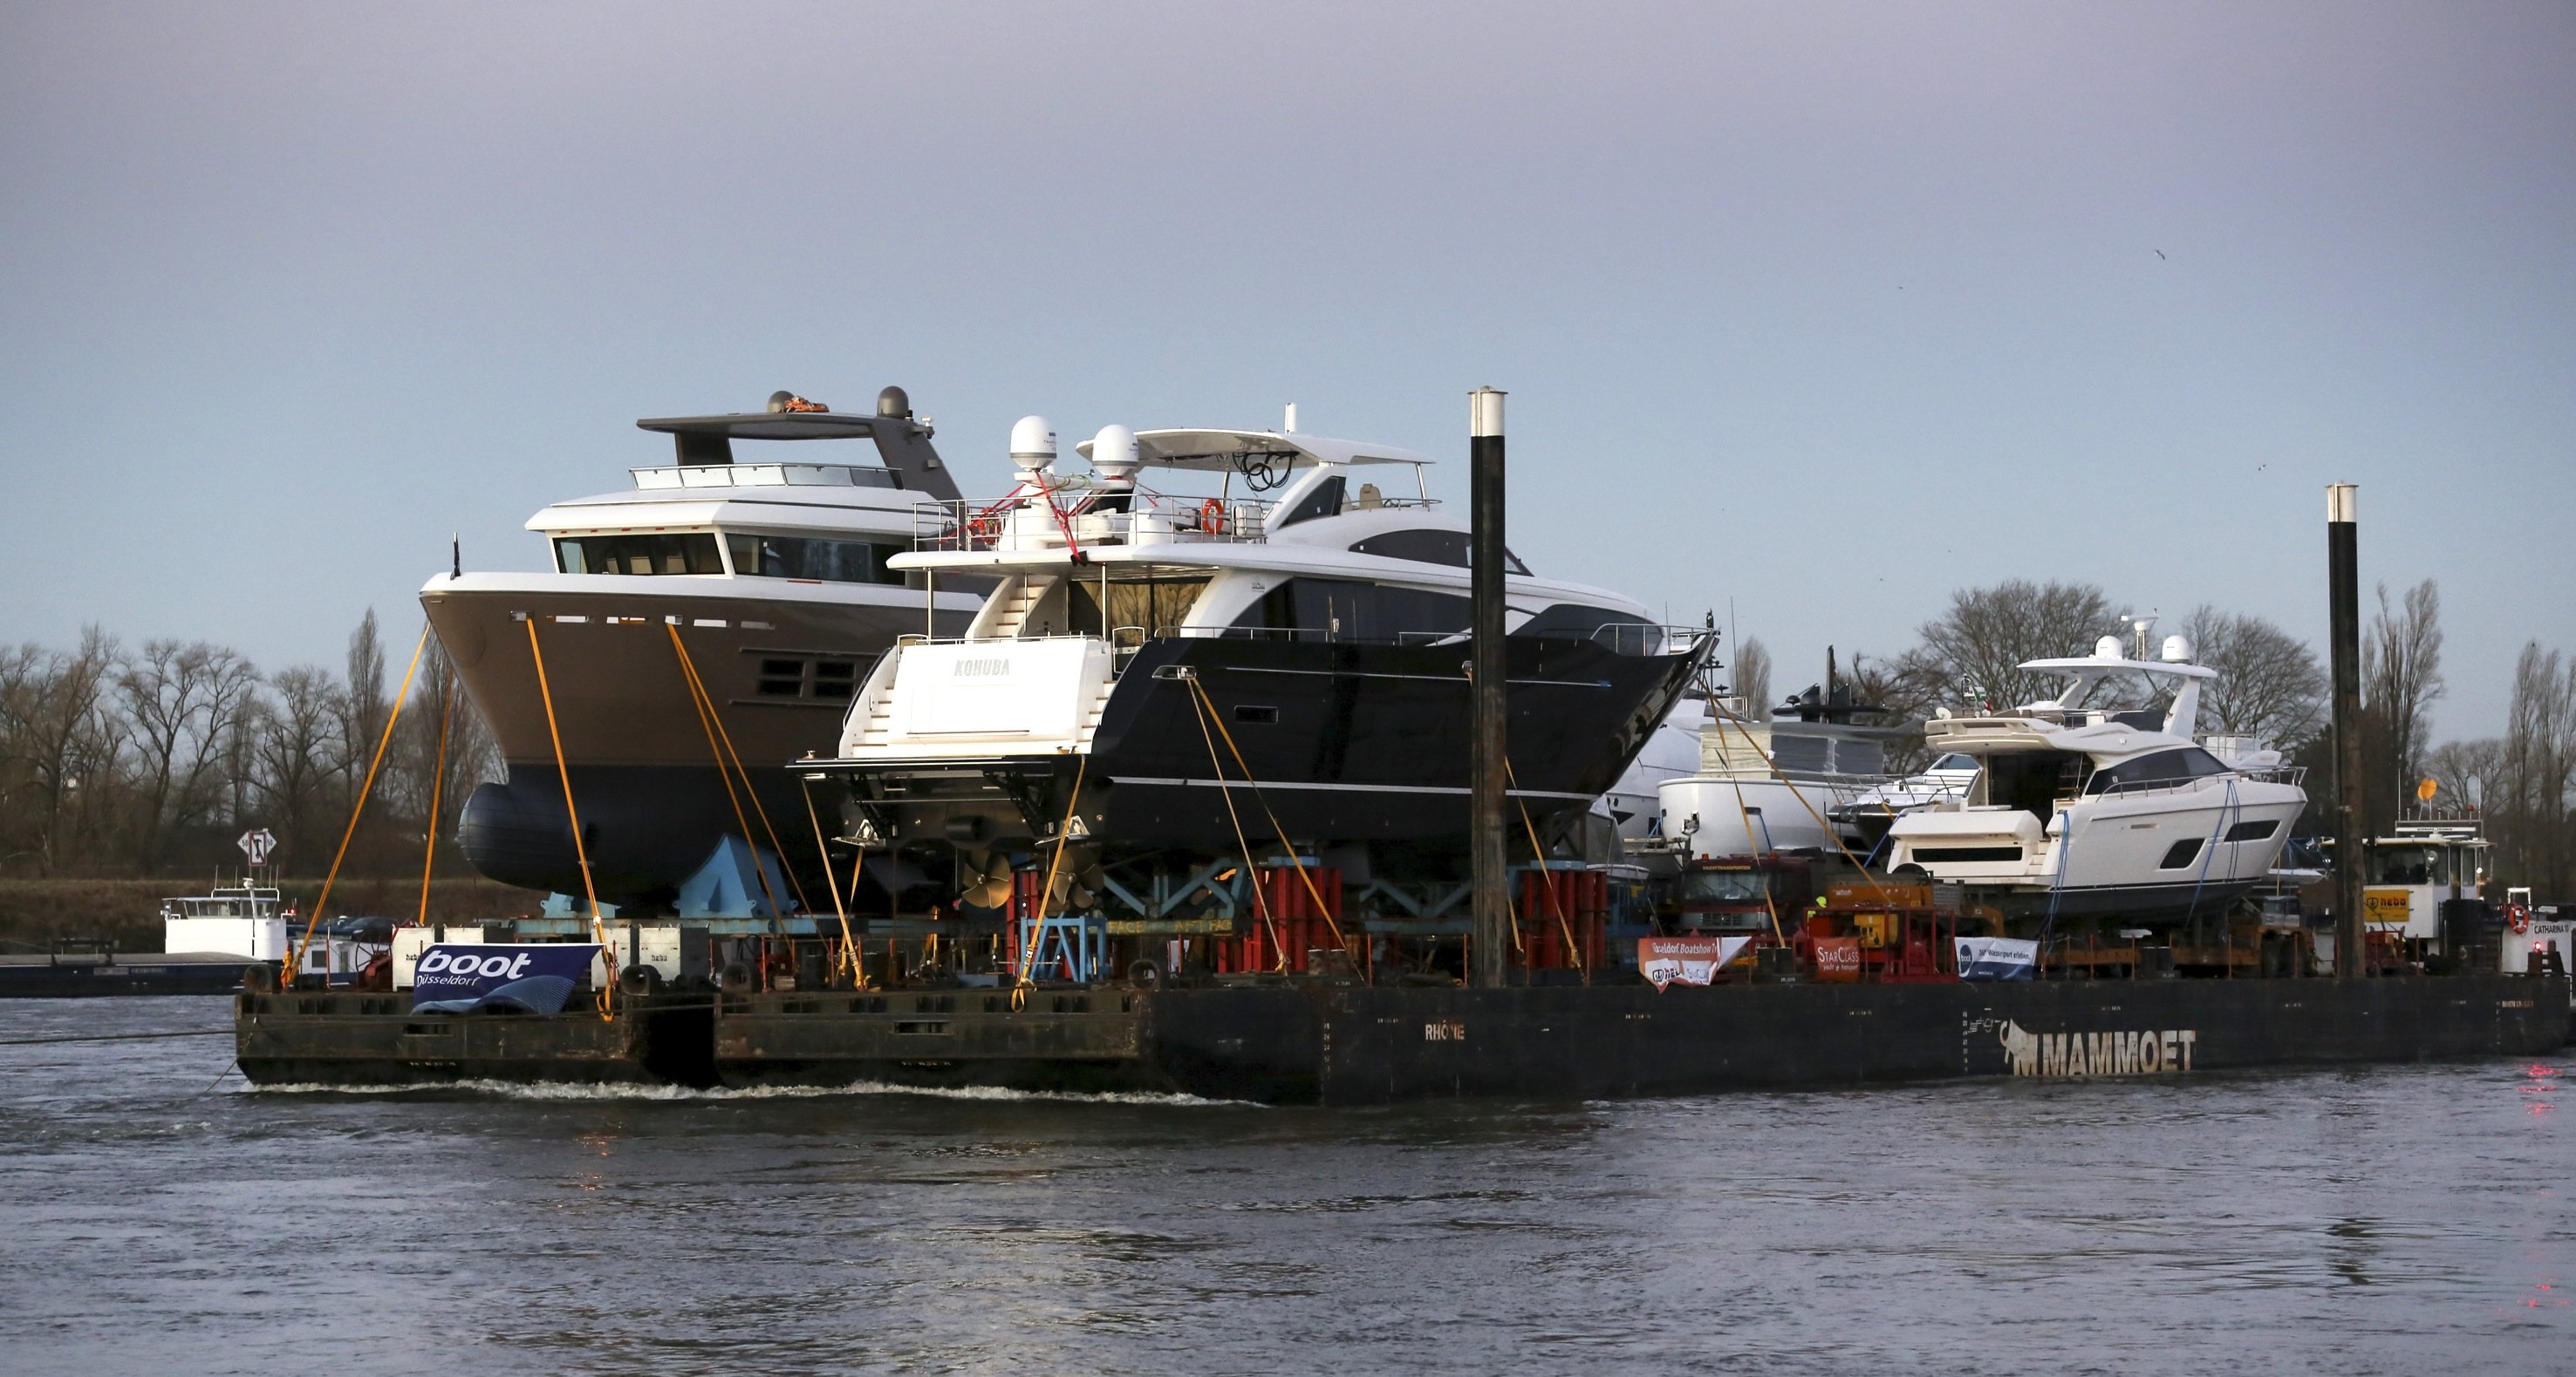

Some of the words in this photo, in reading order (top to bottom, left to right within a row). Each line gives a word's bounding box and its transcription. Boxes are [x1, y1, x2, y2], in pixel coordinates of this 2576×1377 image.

[954, 658, 1009, 677] KOHUBA
[1680, 944, 1712, 954] Boatshow
[419, 950, 531, 980] boot
[417, 974, 481, 988] Düsseldorf
[2042, 1030, 2197, 1076] MAMMOET
